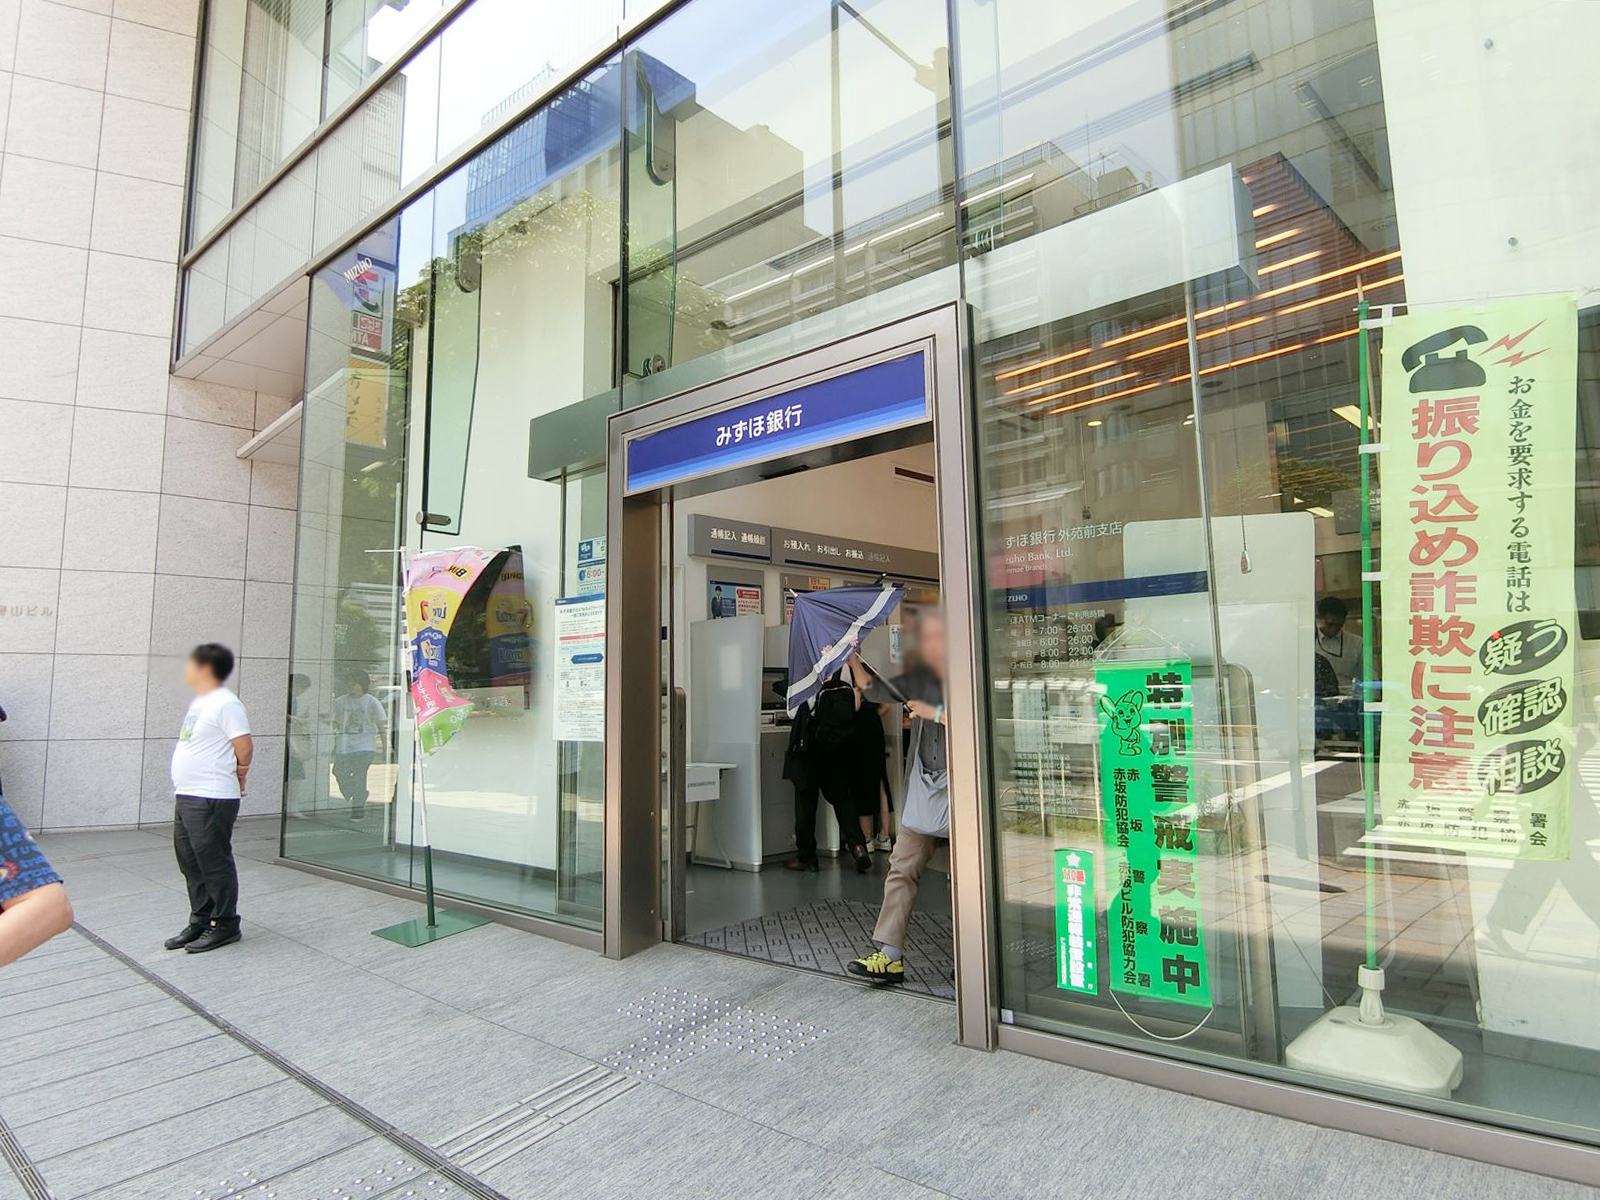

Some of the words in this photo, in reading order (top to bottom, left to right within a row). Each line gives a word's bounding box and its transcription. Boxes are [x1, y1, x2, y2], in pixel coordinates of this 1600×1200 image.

[344, 257, 373, 283] MIZUHO
[716, 404, 803, 447] みずほ銀行
[1506, 376, 1535, 613] お金を要求する電話は
[711, 528, 737, 542] 通帳記入
[784, 539, 811, 552] お預入れ
[817, 545, 842, 556] お引出し
[845, 549, 865, 560] お振込
[1028, 550, 1053, 562] Bank,
[1056, 547, 1074, 558] Ltd.
[1059, 521, 1122, 541] 外苑前支店
[1409, 396, 1481, 795] 振り込め詐欺に注意
[1484, 618, 1562, 675] 疑う
[1483, 676, 1562, 737] 確認
[1482, 738, 1561, 796] 相談
[1146, 672, 1201, 994] 特別警戒実施中
[1127, 768, 1150, 988] 赤坂警察署
